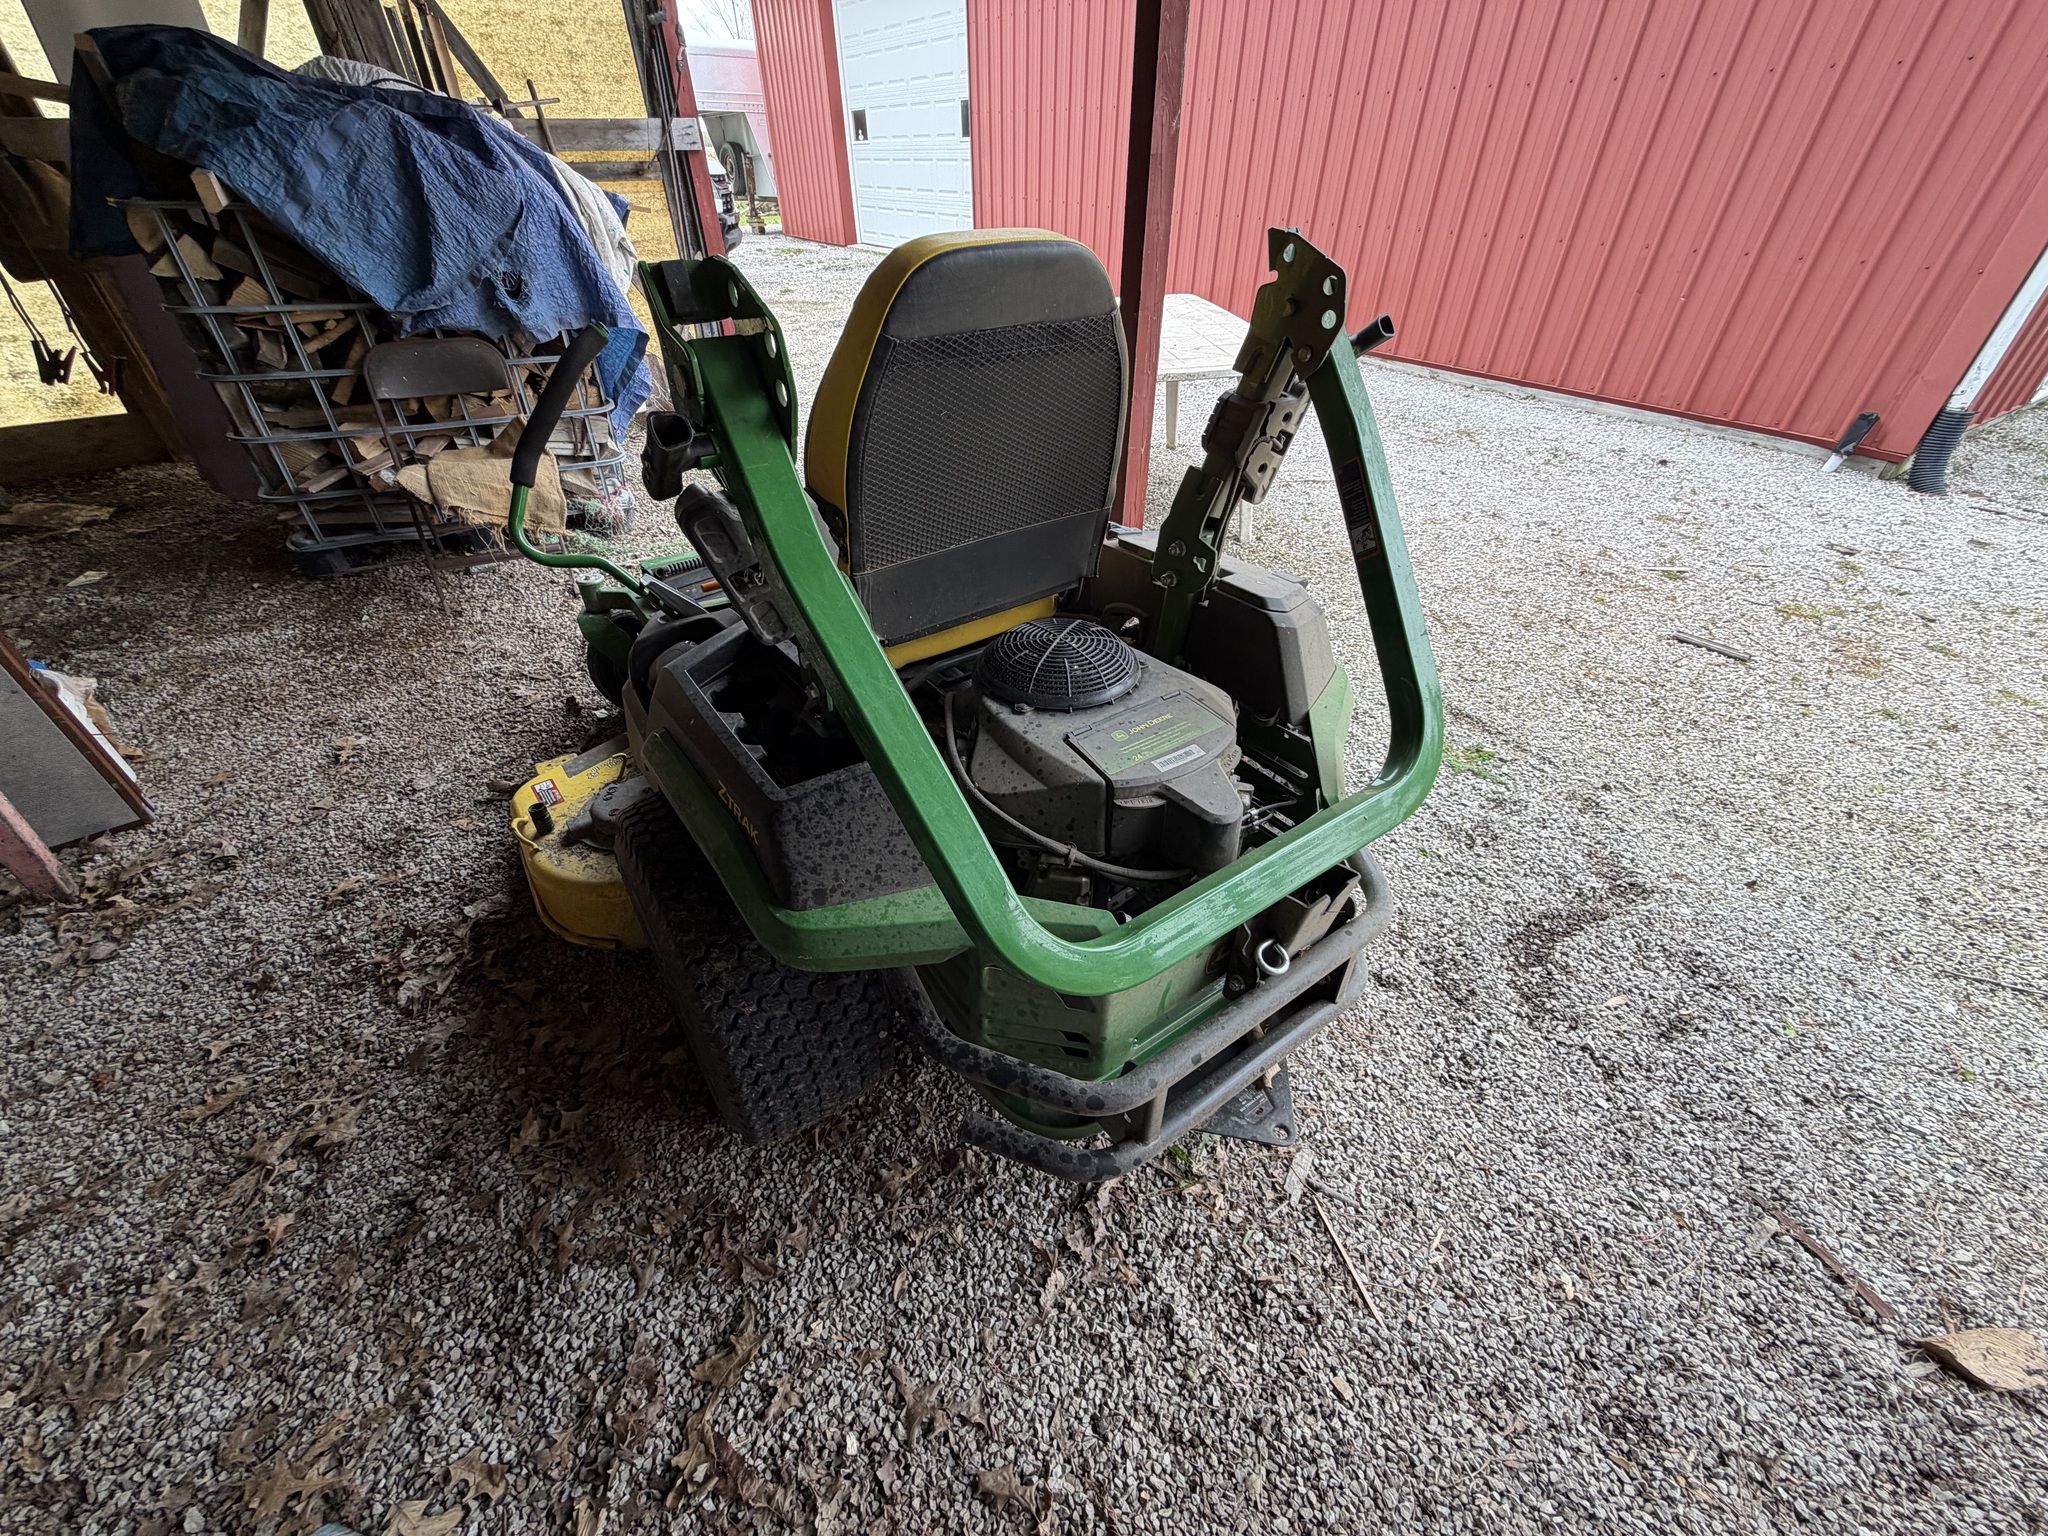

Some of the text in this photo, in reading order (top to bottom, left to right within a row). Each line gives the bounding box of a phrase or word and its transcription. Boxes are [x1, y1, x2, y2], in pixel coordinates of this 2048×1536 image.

[1129, 713, 1174, 735] JOHN DEERE
[718, 779, 759, 846] ZTRAK
